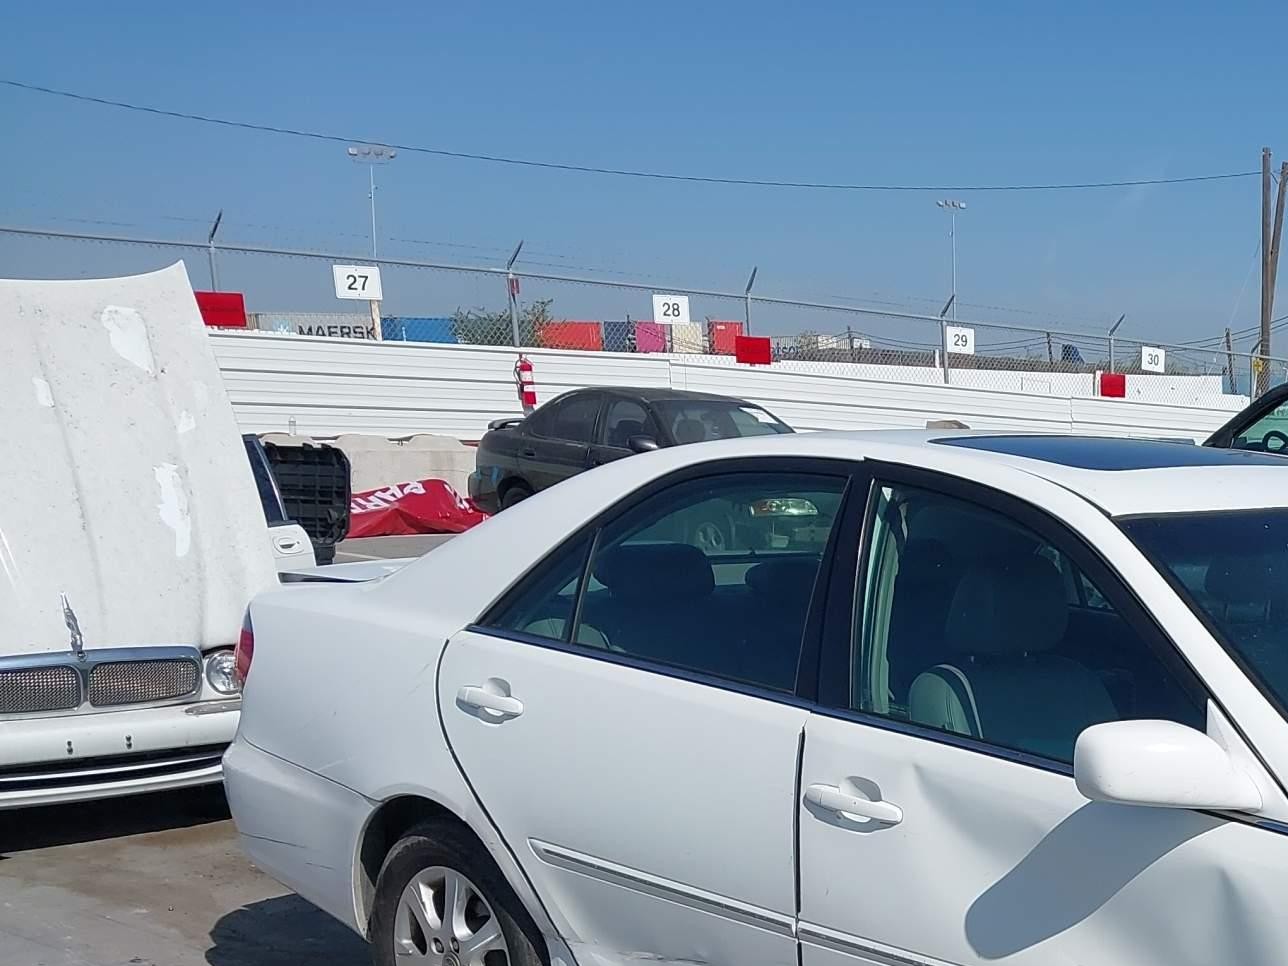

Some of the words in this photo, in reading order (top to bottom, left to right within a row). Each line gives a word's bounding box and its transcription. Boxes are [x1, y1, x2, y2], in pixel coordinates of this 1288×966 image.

[346, 274, 369, 291] 27
[662, 302, 681, 317] 28
[298, 325, 377, 340] MAERSK
[953, 333, 968, 347] 29
[1147, 353, 1160, 366] 30
